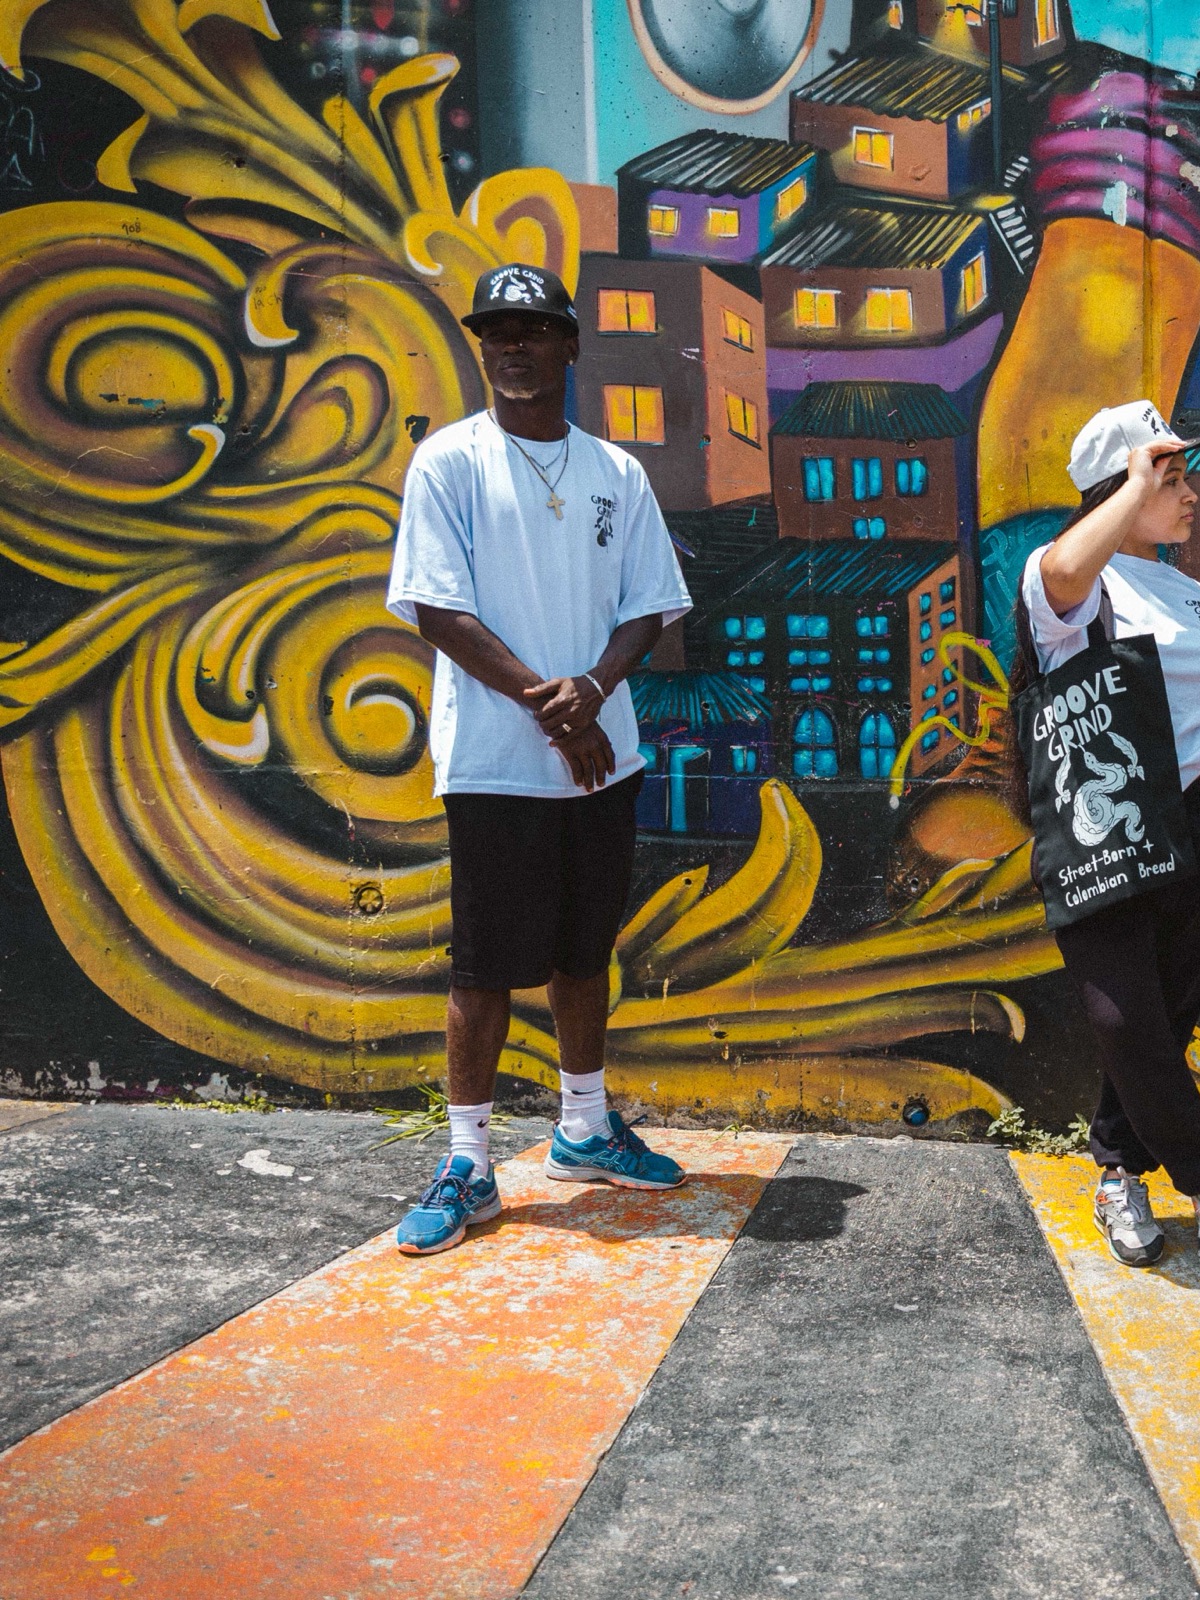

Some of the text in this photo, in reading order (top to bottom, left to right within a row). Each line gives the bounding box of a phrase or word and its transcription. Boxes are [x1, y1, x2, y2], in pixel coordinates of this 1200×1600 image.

[490, 267, 545, 286] GROOVE GRIND
[591, 495, 618, 513] GROOE
[1033, 665, 1127, 742] GROOVE
[1048, 703, 1112, 762] GRIND
[1058, 845, 1137, 887] Street-Born
[1065, 853, 1176, 908] Colombian Bread
